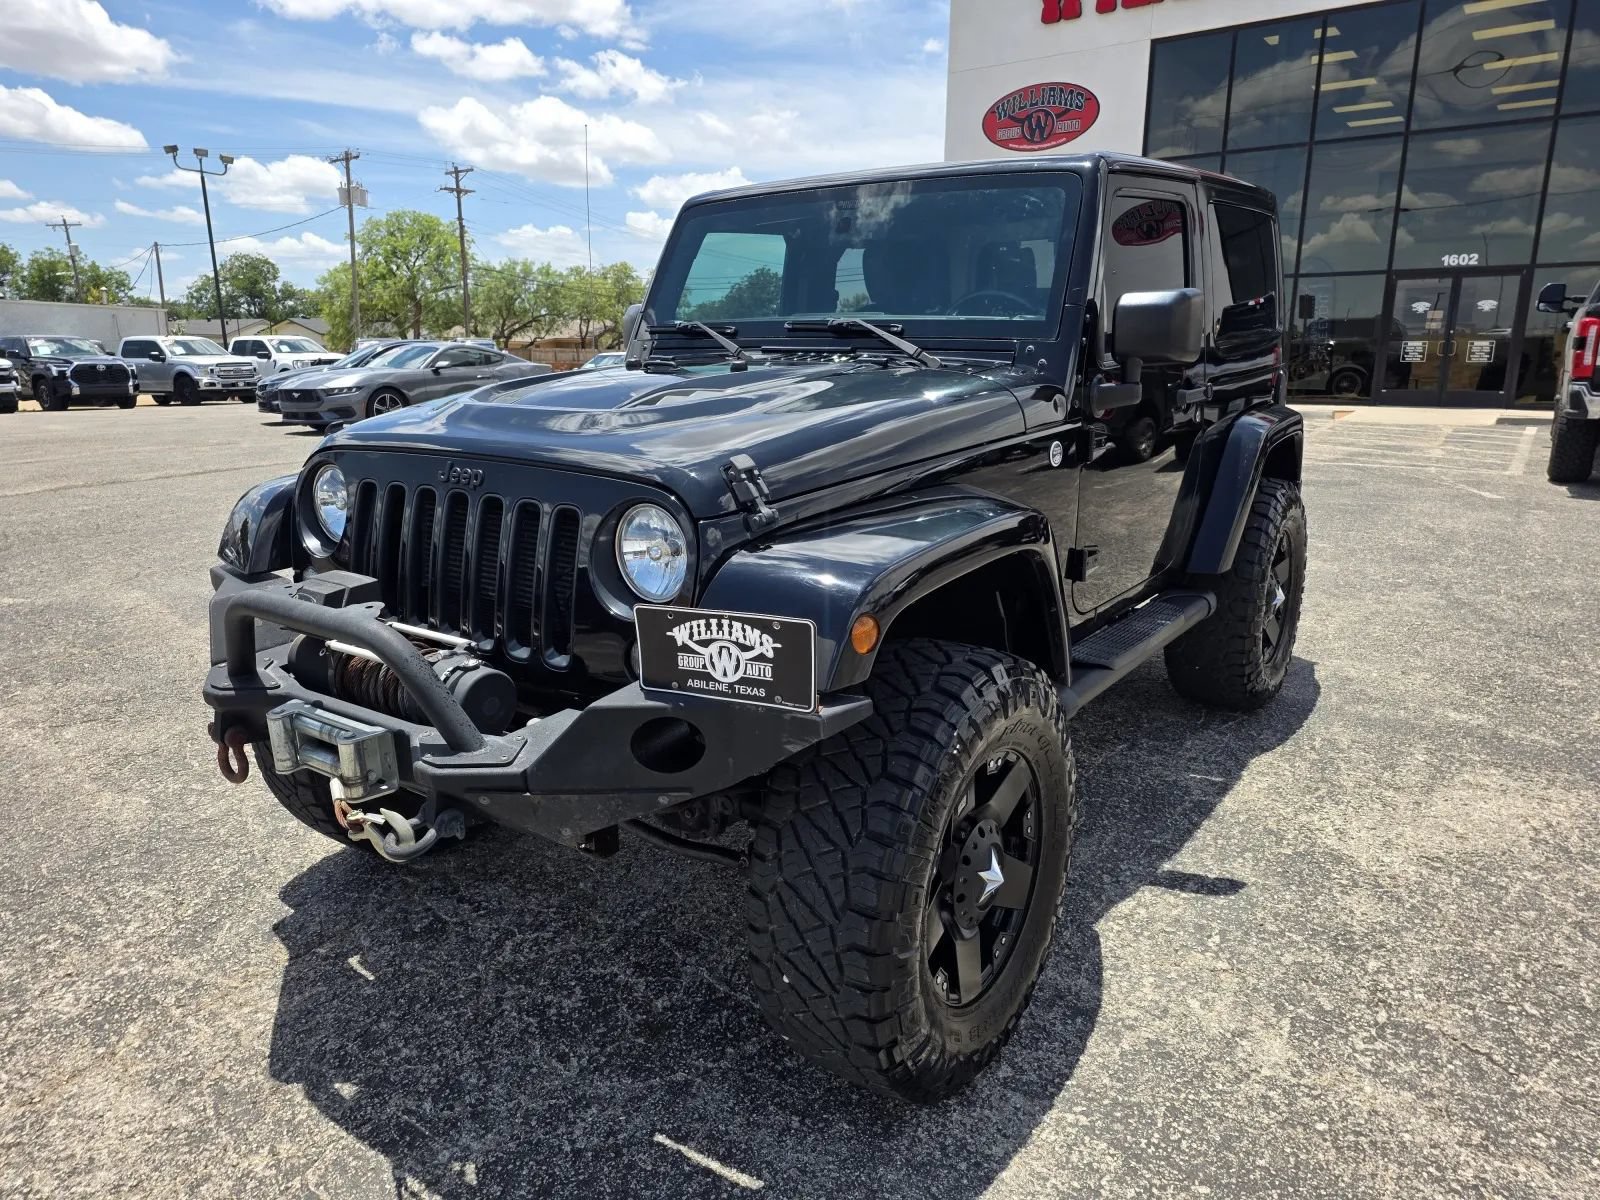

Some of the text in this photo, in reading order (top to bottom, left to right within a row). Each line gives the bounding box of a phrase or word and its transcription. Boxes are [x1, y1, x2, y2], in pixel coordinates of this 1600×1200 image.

[996, 86, 1086, 121] WILLIAMS
[1056, 119, 1080, 133] AUTO
[1441, 253, 1479, 266] 1602
[438, 460, 483, 488] Jeep
[672, 618, 774, 659] WILLIAMS
[678, 647, 772, 680] GROUP W AUTO
[687, 678, 766, 697] ABILENE, TEXAS
